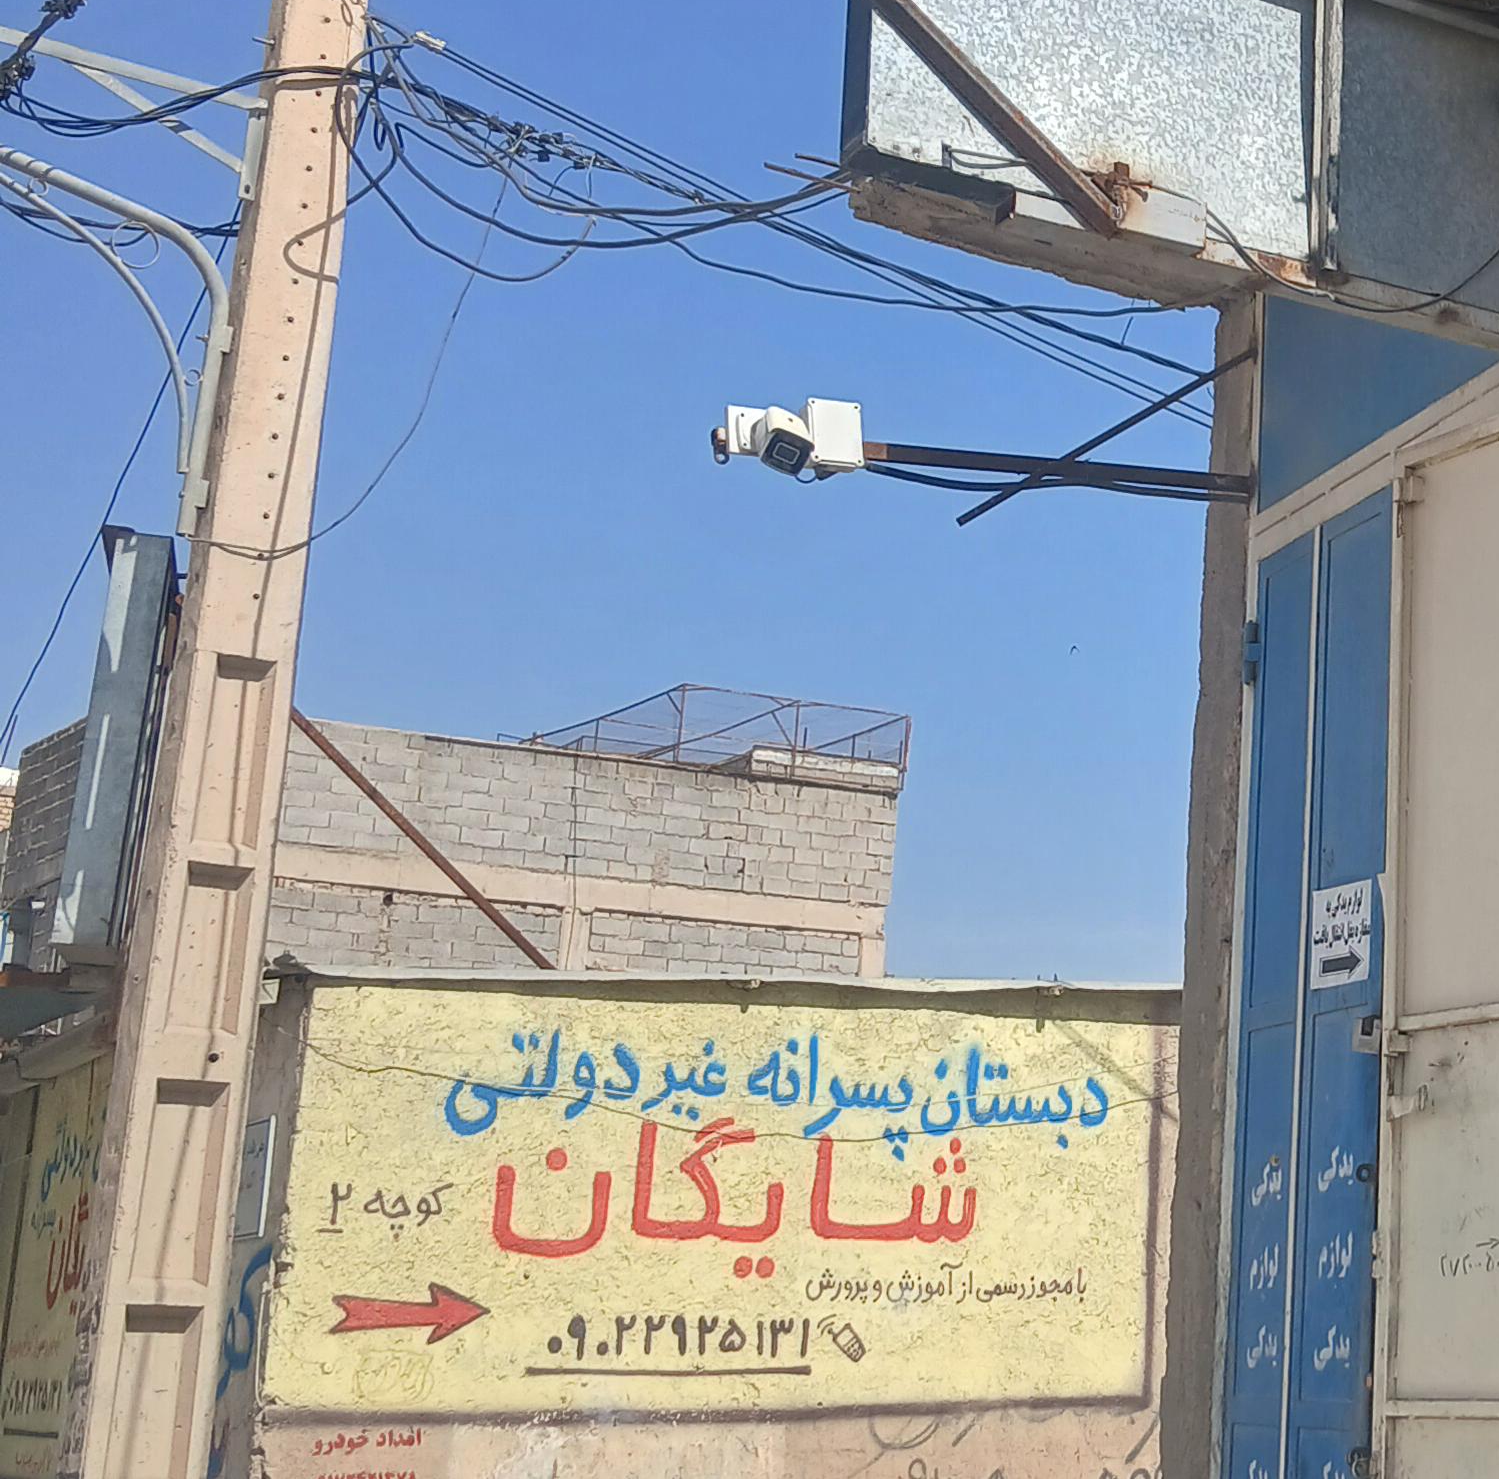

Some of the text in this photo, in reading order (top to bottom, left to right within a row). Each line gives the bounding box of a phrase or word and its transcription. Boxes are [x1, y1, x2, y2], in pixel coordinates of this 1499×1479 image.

[748, 1033, 914, 1161] پسرانه
[920, 1044, 1110, 1149] دبستان
[329, 1181, 454, 1239] کوچه ۲
[492, 1117, 977, 1279] شایگان
[1250, 1243, 1279, 1289] لوازم
[1318, 1231, 1353, 1279] لوازم
[805, 1267, 868, 1304] پرورش
[872, 1278, 883, 1303] و
[886, 1261, 964, 1304] آموزش
[956, 1270, 973, 1305] از
[976, 1278, 1026, 1304] رسمی
[1026, 1274, 1073, 1303] مجوز
[311, 1427, 422, 1456] امداد خودرو
